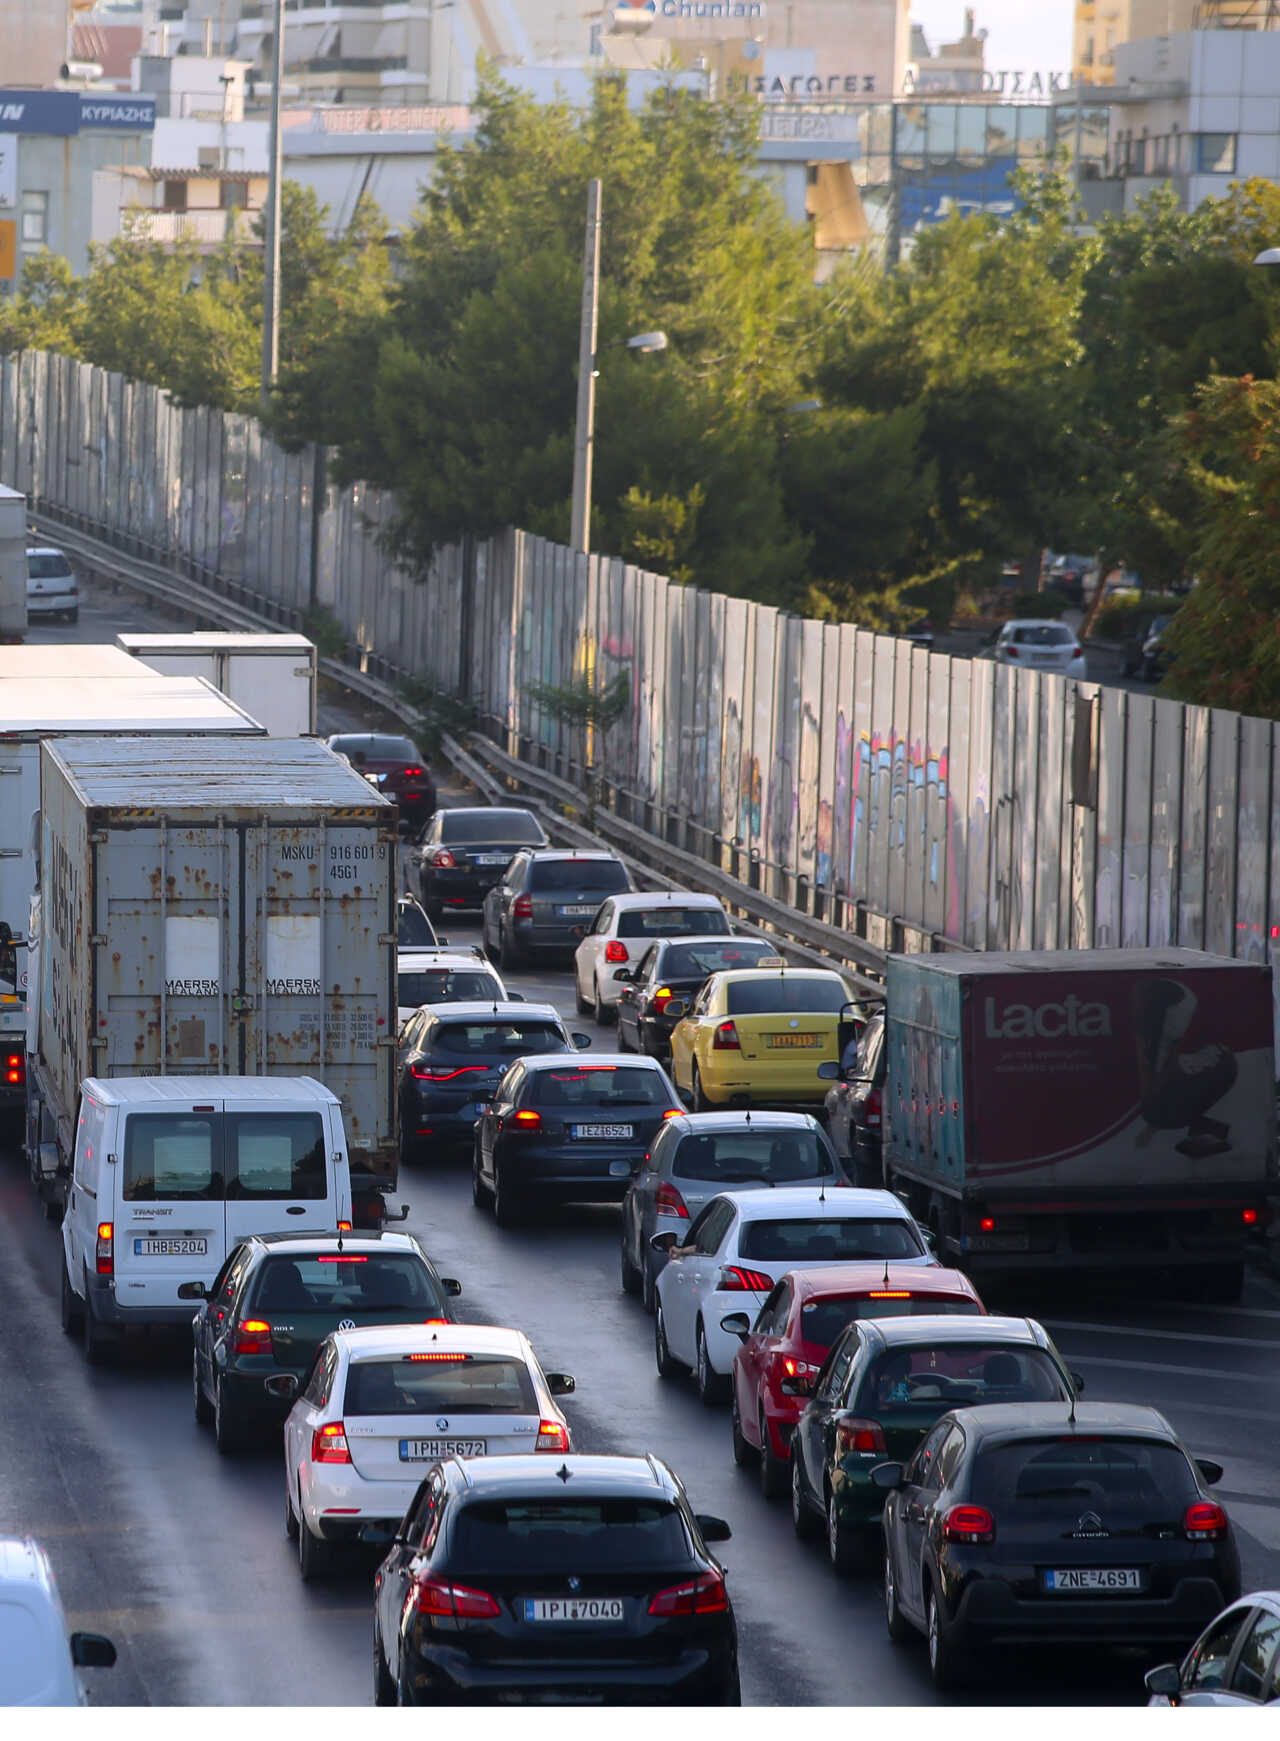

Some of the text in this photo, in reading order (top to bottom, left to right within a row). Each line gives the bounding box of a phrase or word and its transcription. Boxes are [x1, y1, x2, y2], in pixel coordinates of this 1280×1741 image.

[82, 106, 154, 122] ΚΥΡΙΑΖΗΣ
[281, 846, 314, 861] MSKU
[330, 864, 358, 879] 45G1
[984, 994, 1112, 1038] Lacta
